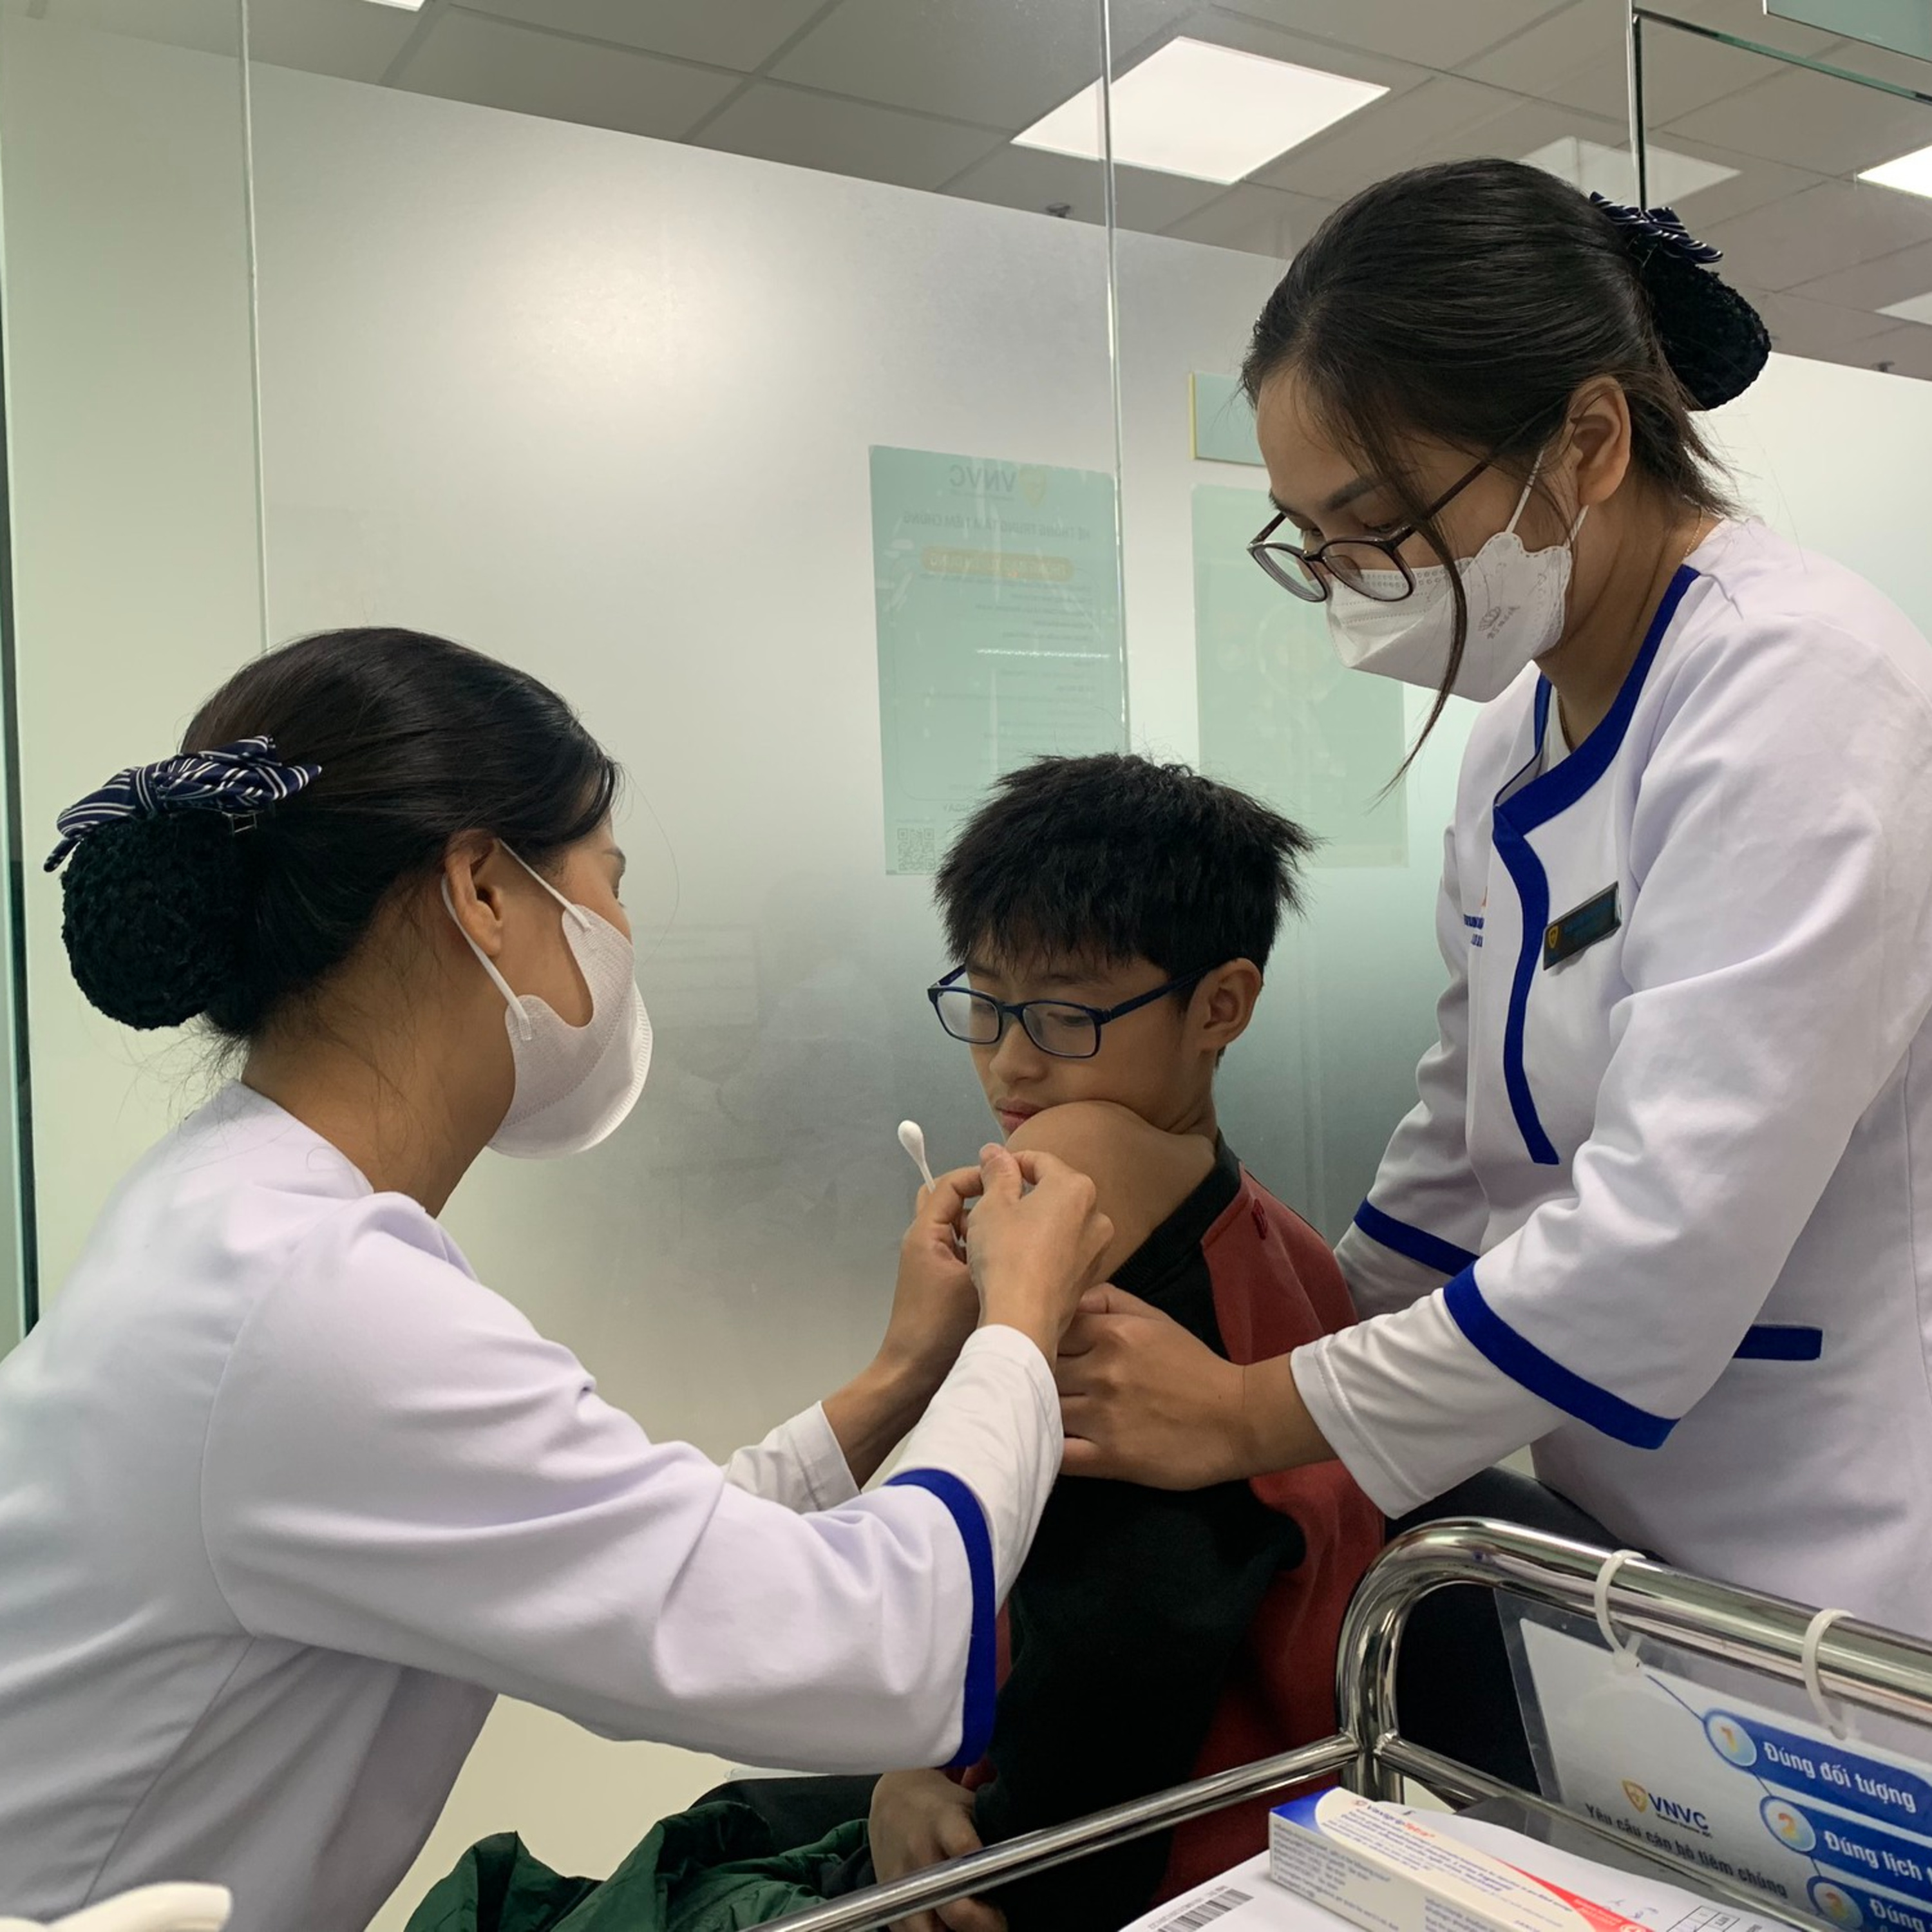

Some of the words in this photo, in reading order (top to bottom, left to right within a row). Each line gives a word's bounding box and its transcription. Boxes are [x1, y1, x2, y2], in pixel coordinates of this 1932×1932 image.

[1721, 1727, 1738, 1752] 1
[1763, 1741, 1815, 1779] Đúng
[1819, 1761, 1851, 1788] đối
[1855, 1773, 1917, 1814] tượng
[1648, 1792, 1709, 1830] VNVC
[1778, 1812, 1798, 1840] 2
[1586, 1803, 1613, 1826] Yêu
[1698, 1850, 1734, 1877] tiêm
[1824, 1830, 1879, 1870] Đúng
[1882, 1850, 1922, 1881] lịch
